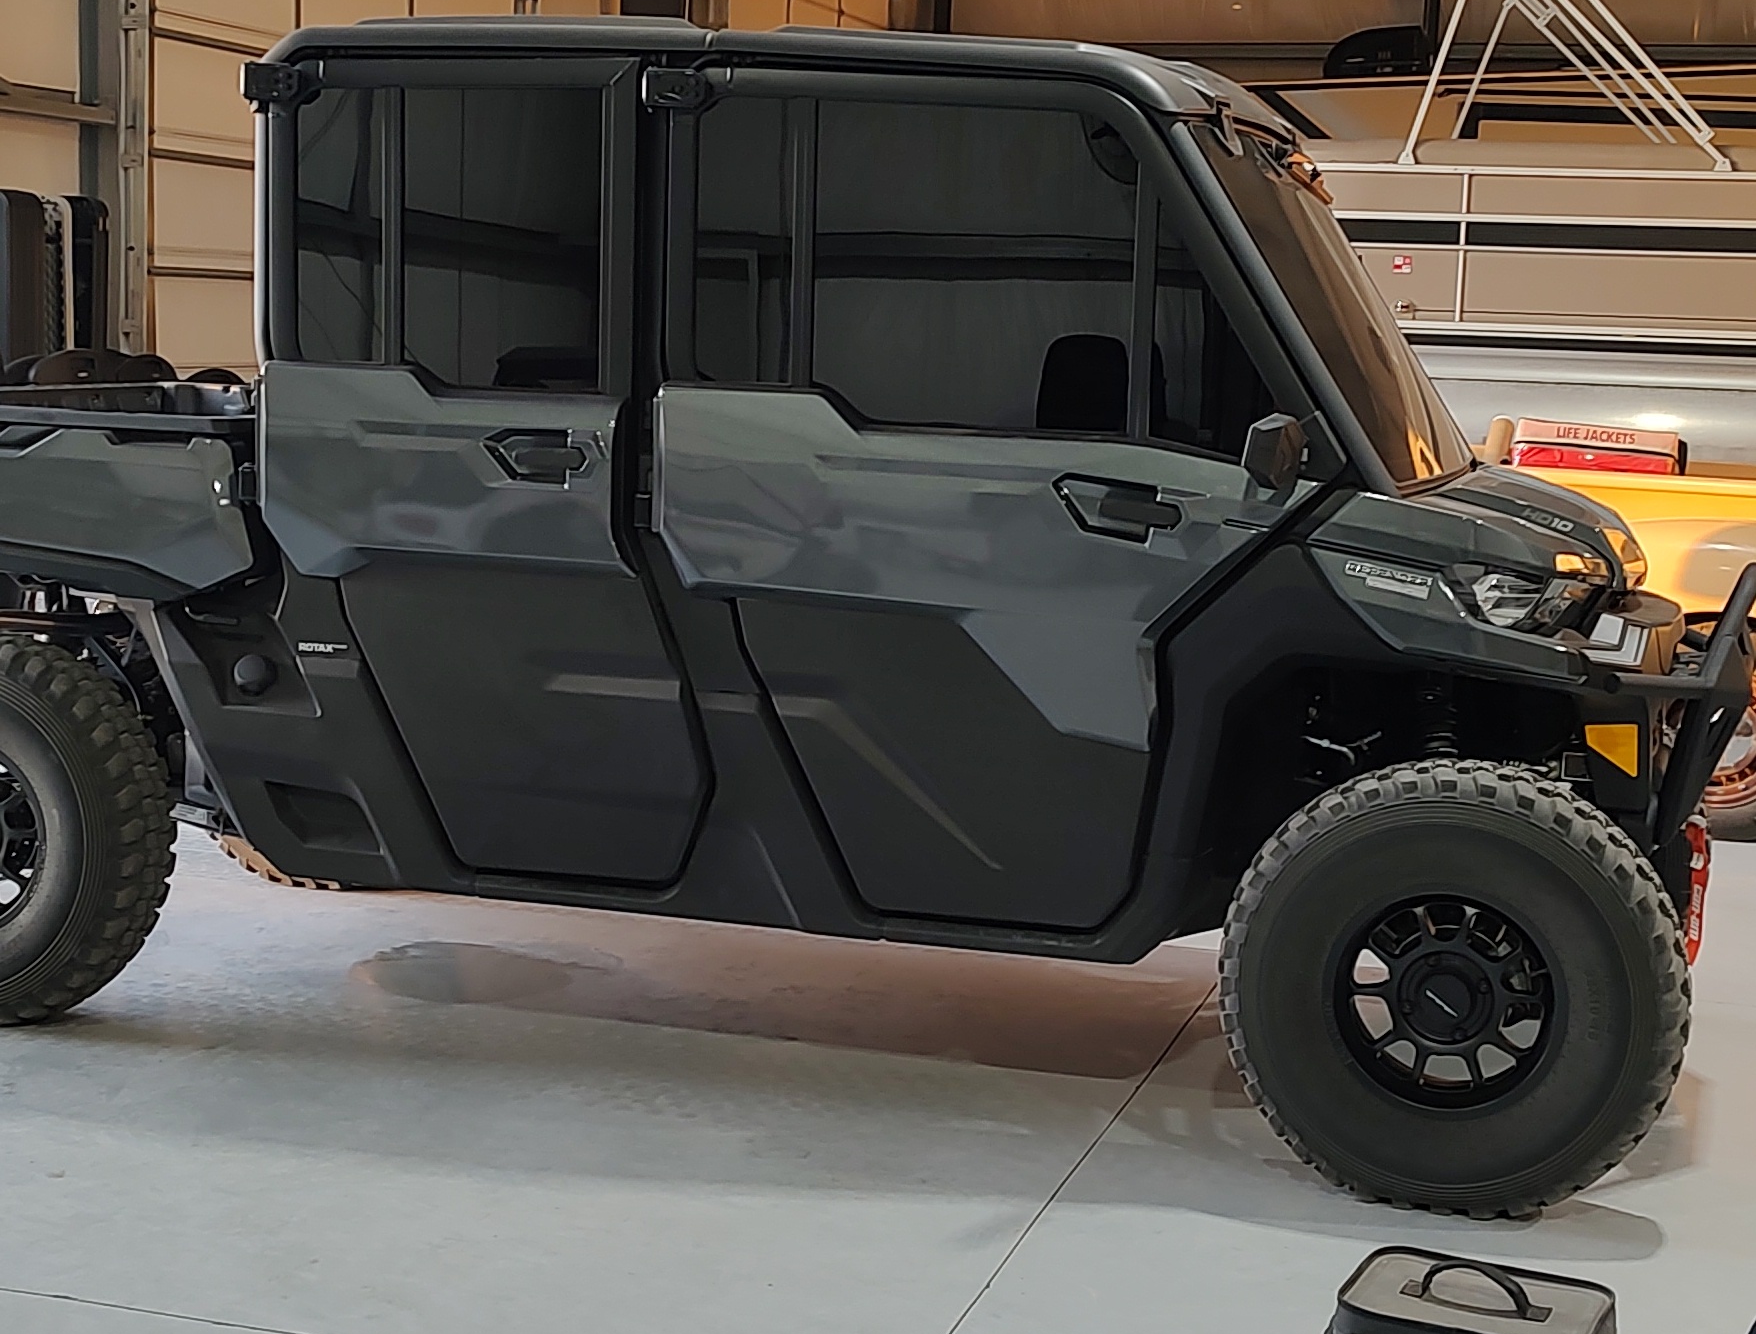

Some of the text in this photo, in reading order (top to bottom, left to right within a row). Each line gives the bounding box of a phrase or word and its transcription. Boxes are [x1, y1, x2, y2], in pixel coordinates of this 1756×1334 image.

[1556, 426, 1636, 445] LIFE JACKETS
[1521, 508, 1575, 532] HD10
[298, 642, 334, 653] ROTAX
